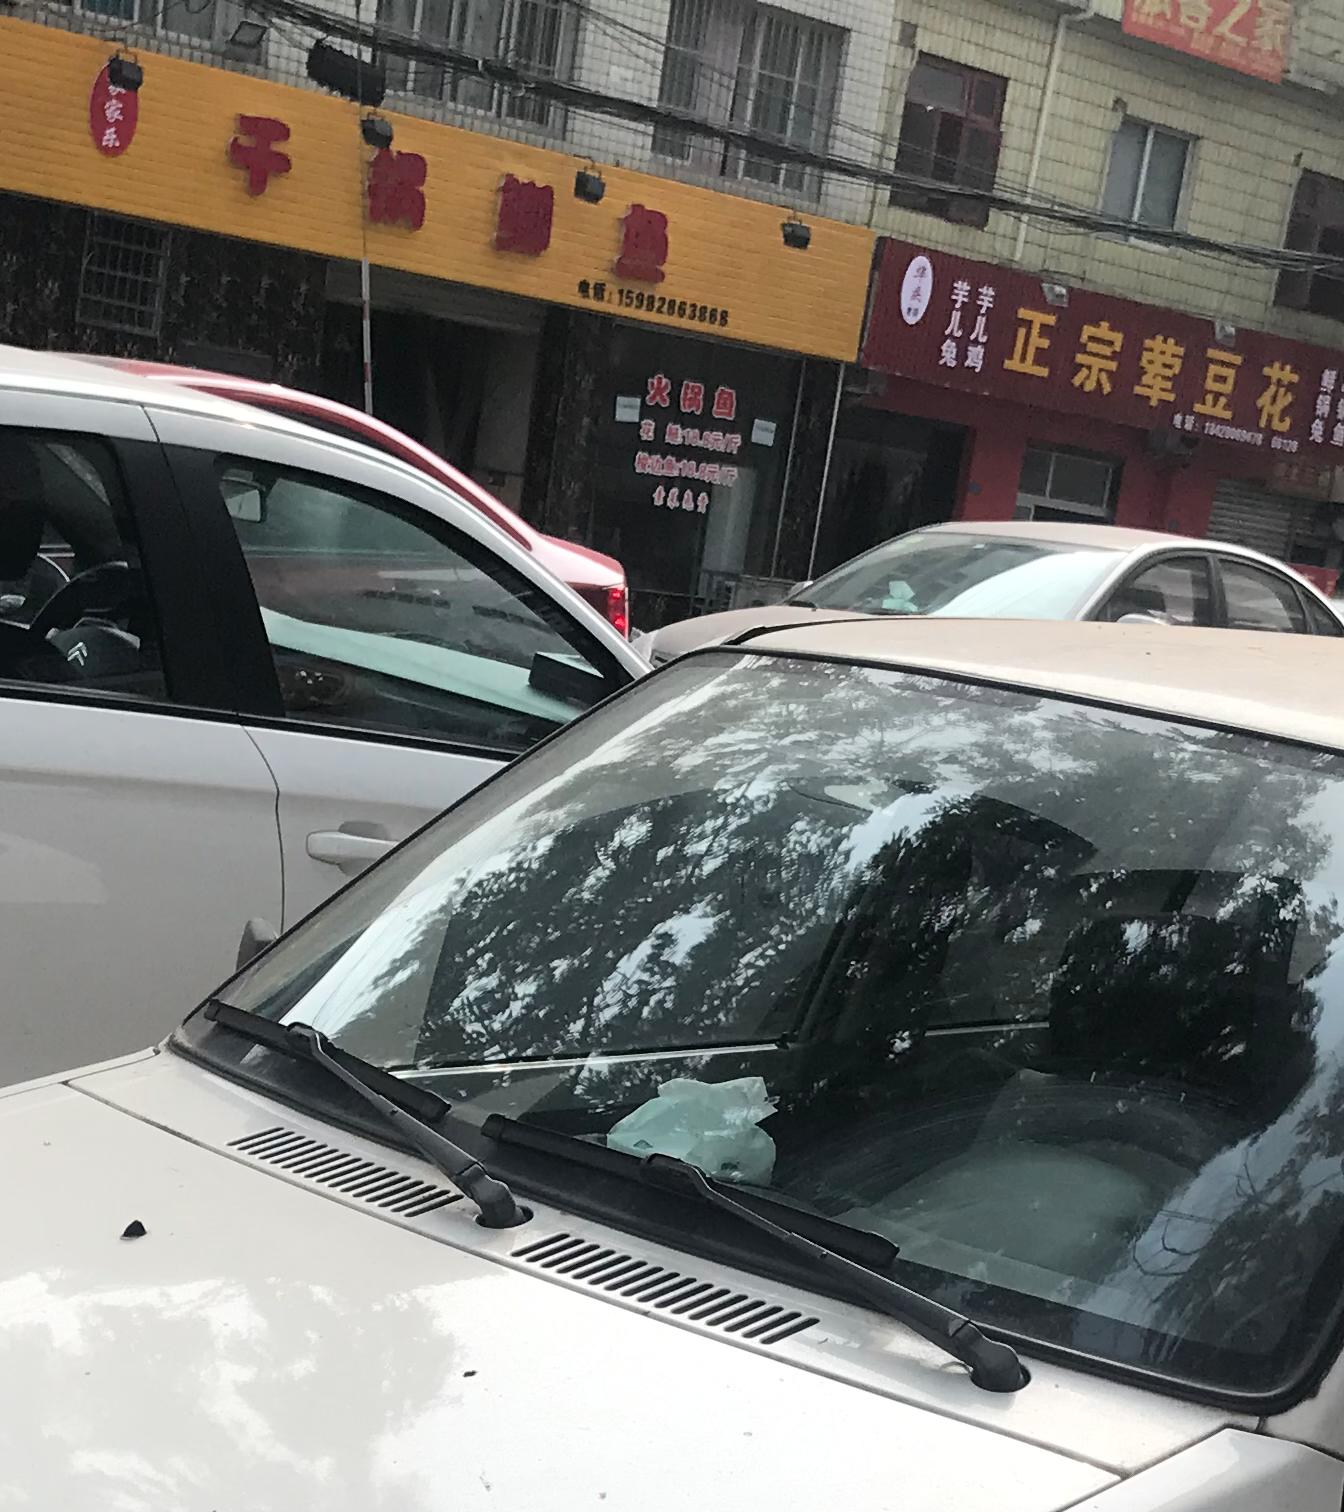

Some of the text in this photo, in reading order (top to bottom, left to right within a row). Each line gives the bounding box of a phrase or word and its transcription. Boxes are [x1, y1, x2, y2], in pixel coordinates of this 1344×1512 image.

[938, 280, 971, 368] 芋儿兔
[964, 285, 995, 373] 芋儿鸡
[1003, 307, 1300, 433] 正宗荤豆花
